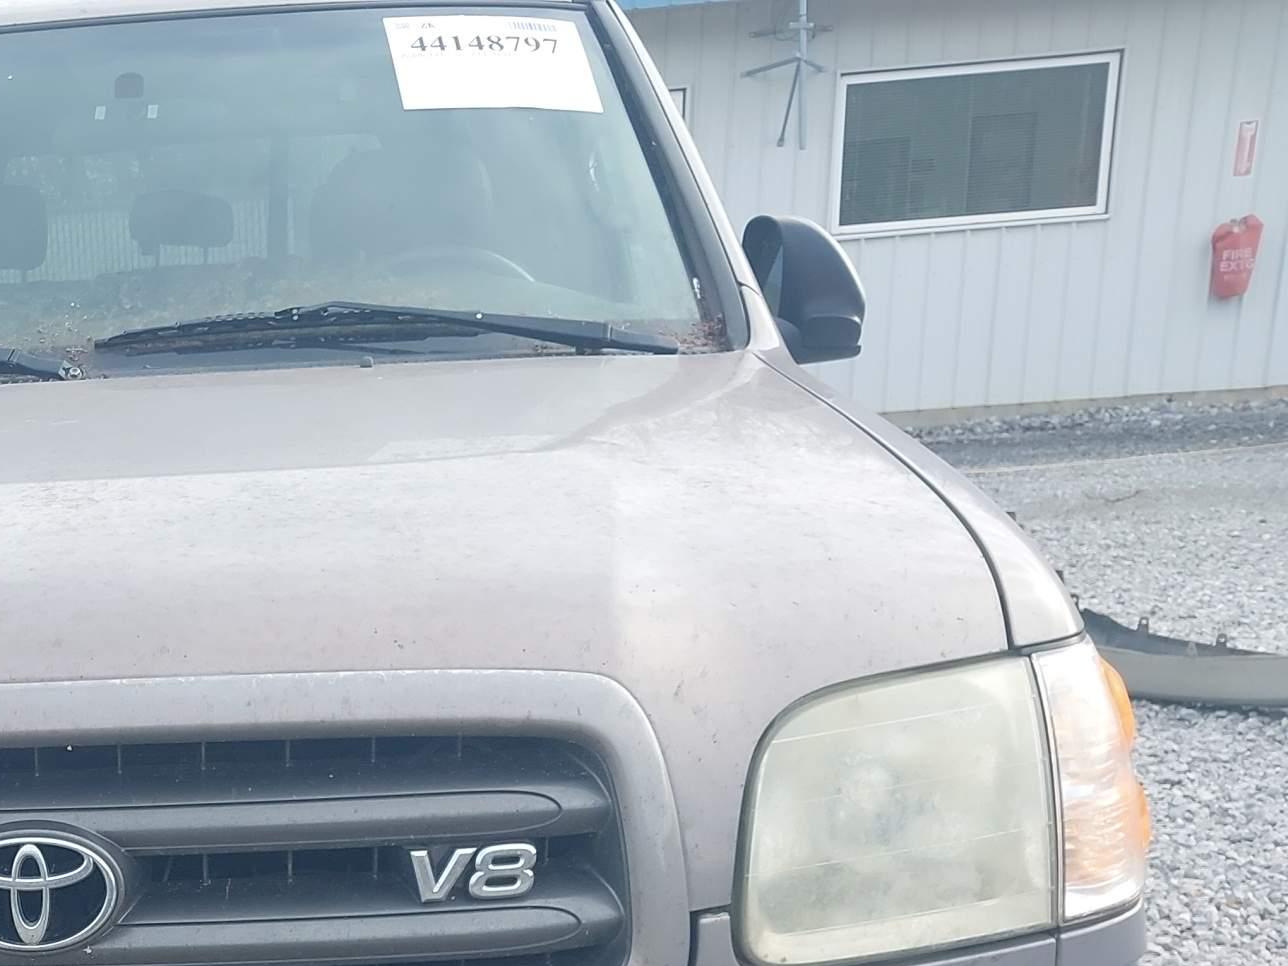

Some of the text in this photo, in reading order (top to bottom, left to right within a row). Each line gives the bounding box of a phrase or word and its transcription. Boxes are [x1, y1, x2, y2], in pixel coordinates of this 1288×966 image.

[410, 35, 558, 54] 44148797
[1222, 248, 1252, 261] FIRE
[410, 843, 537, 903] V8
